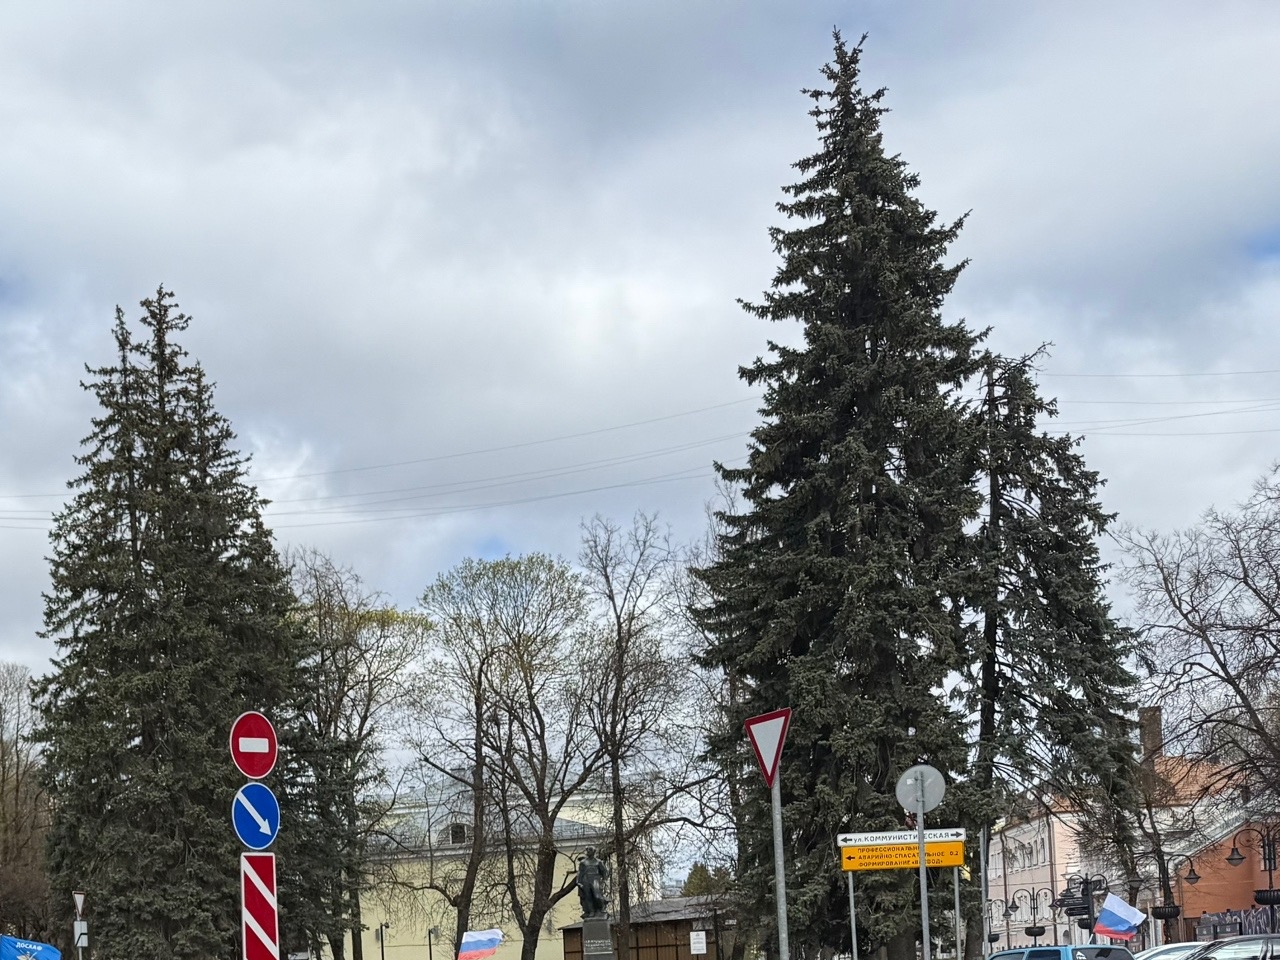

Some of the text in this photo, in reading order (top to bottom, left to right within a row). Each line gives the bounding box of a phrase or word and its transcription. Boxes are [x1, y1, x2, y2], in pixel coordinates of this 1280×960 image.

[864, 832, 949, 843] КОММУНИСТИЕСКАЯ
[858, 845, 921, 853] ПРОФЕССИОНАЛЬН
[858, 852, 945, 860] АВАРИЙНО-СПАСАТЛЬНОЕ
[15, 942, 43, 951] ДОСААФ
